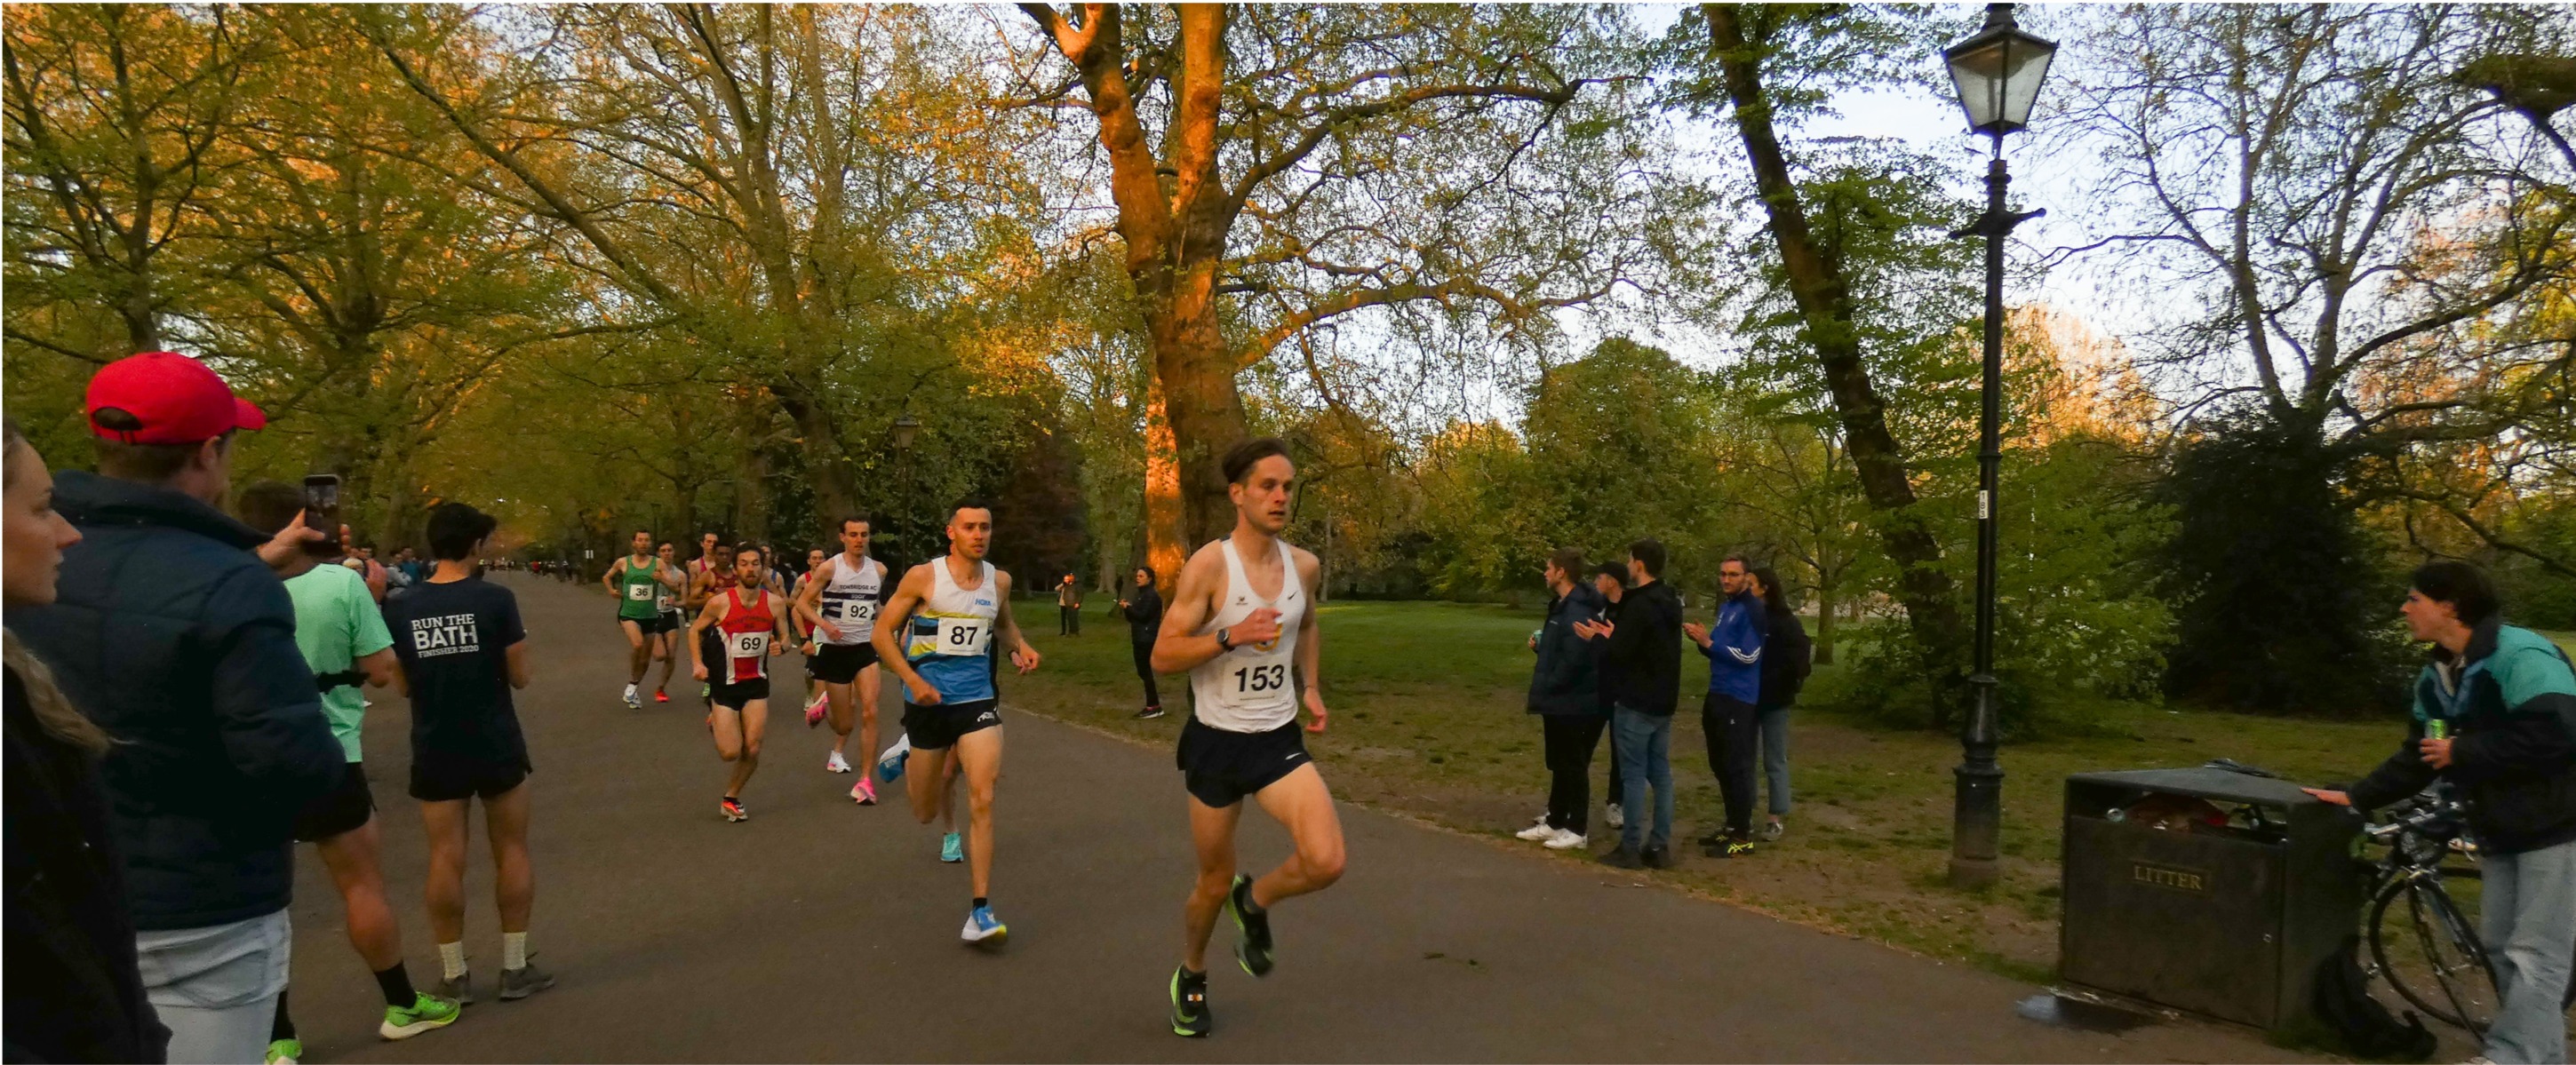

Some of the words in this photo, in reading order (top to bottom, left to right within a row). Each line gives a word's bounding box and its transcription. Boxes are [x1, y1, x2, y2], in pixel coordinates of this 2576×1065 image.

[635, 587, 649, 597] 36
[850, 605, 868, 618] 92
[411, 616, 443, 630] RUN
[446, 614, 475, 625] THE
[413, 624, 478, 649] BATH
[741, 637, 762, 650] 69
[950, 625, 978, 646] 87
[418, 647, 458, 658] FINISHER
[1234, 664, 1285, 693] 153
[2134, 865, 2203, 890] LITTER
